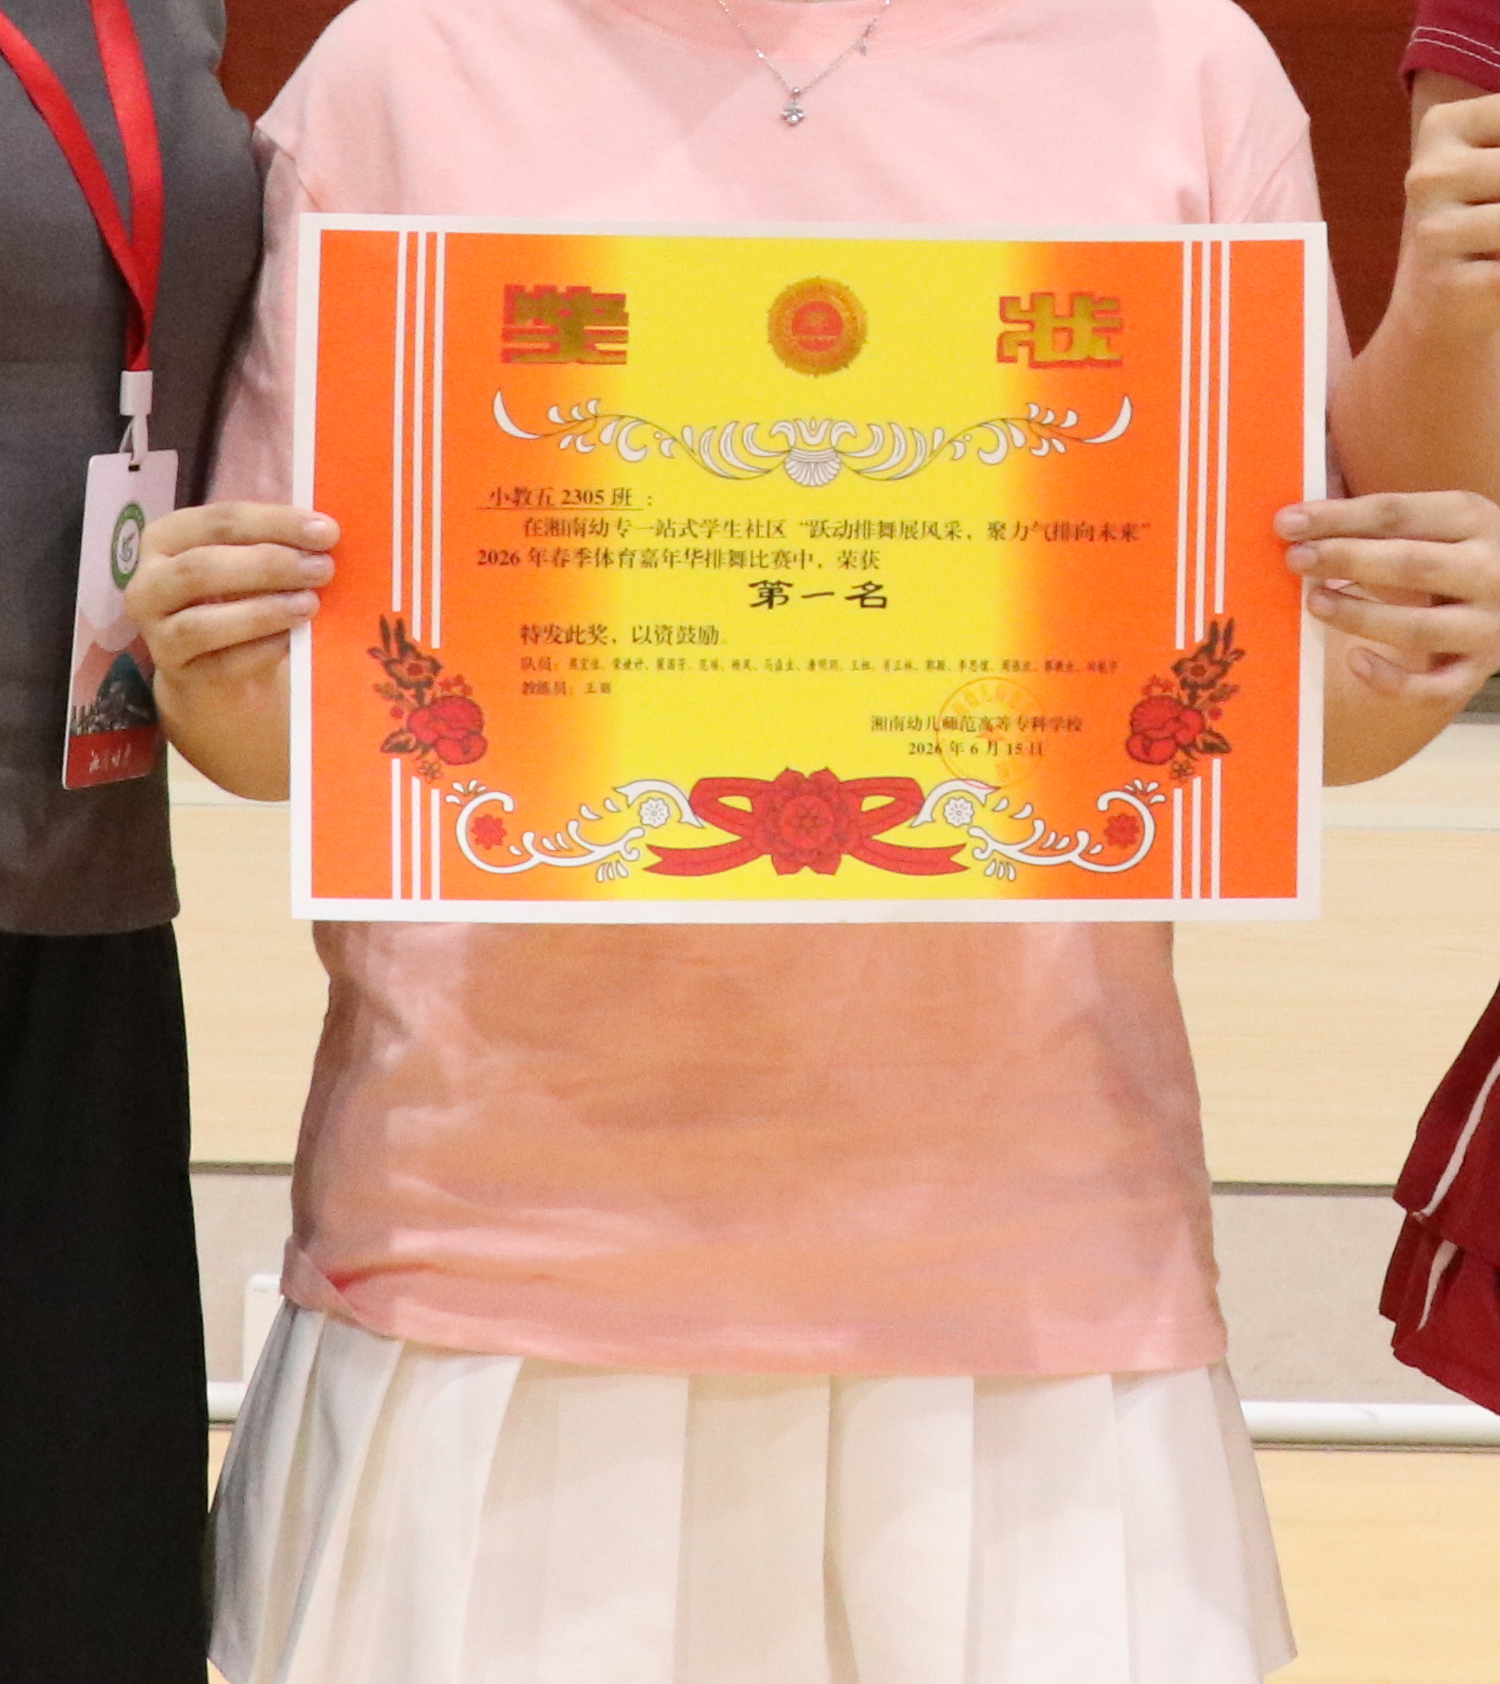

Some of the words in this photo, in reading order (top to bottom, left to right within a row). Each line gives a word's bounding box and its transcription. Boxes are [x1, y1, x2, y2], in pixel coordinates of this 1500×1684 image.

[748, 580, 888, 609] 第一名
[871, 715, 1084, 733] 湘南幼儿师范高等专科学校
